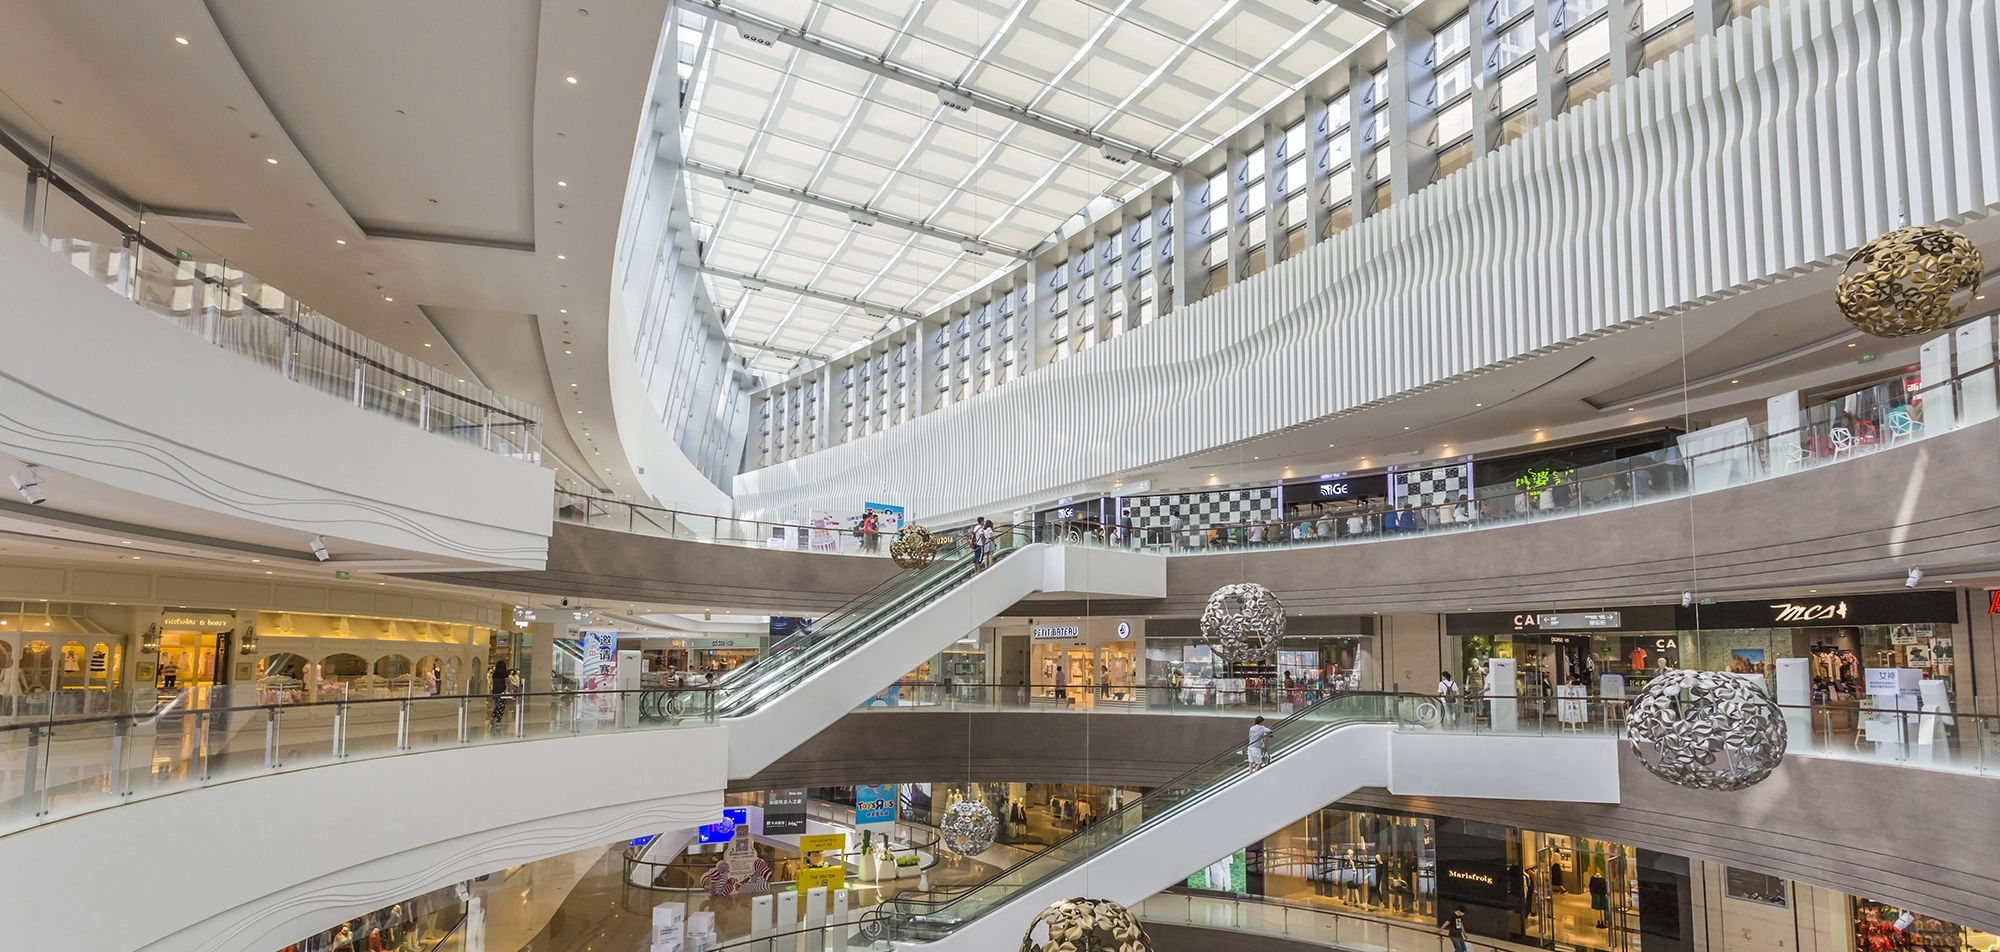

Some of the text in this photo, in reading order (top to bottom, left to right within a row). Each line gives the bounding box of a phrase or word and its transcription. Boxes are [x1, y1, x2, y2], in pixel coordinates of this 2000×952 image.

[1033, 626, 1079, 637] PETIT BATEAU
[1448, 869, 1493, 885] Marisfrolg
